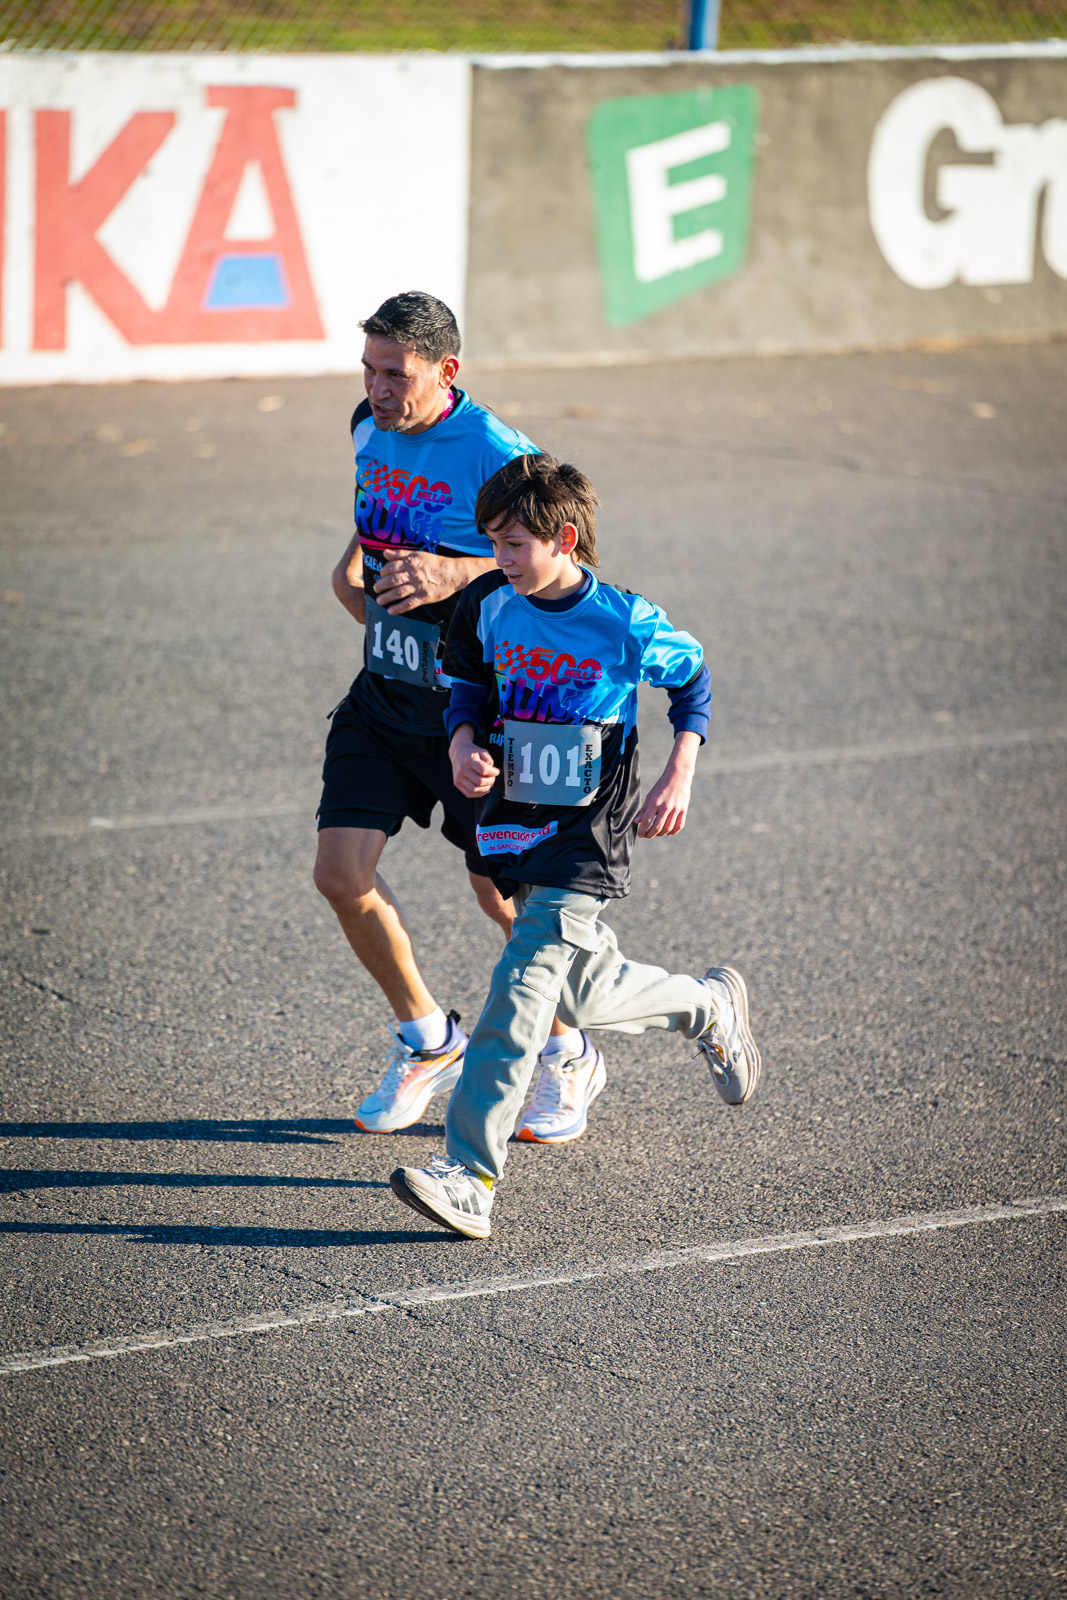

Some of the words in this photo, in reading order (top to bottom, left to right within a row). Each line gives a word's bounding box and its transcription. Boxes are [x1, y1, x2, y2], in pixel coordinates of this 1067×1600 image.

[0, 84, 326, 353] KA
[625, 119, 732, 283] E
[417, 490, 453, 505] MILLAS
[372, 621, 420, 672] 140
[563, 667, 603, 680] MILLAS
[507, 737, 515, 788] TIEMPO
[519, 742, 581, 787] 101
[583, 744, 593, 794] EXACTO
[476, 830, 530, 843] revención
